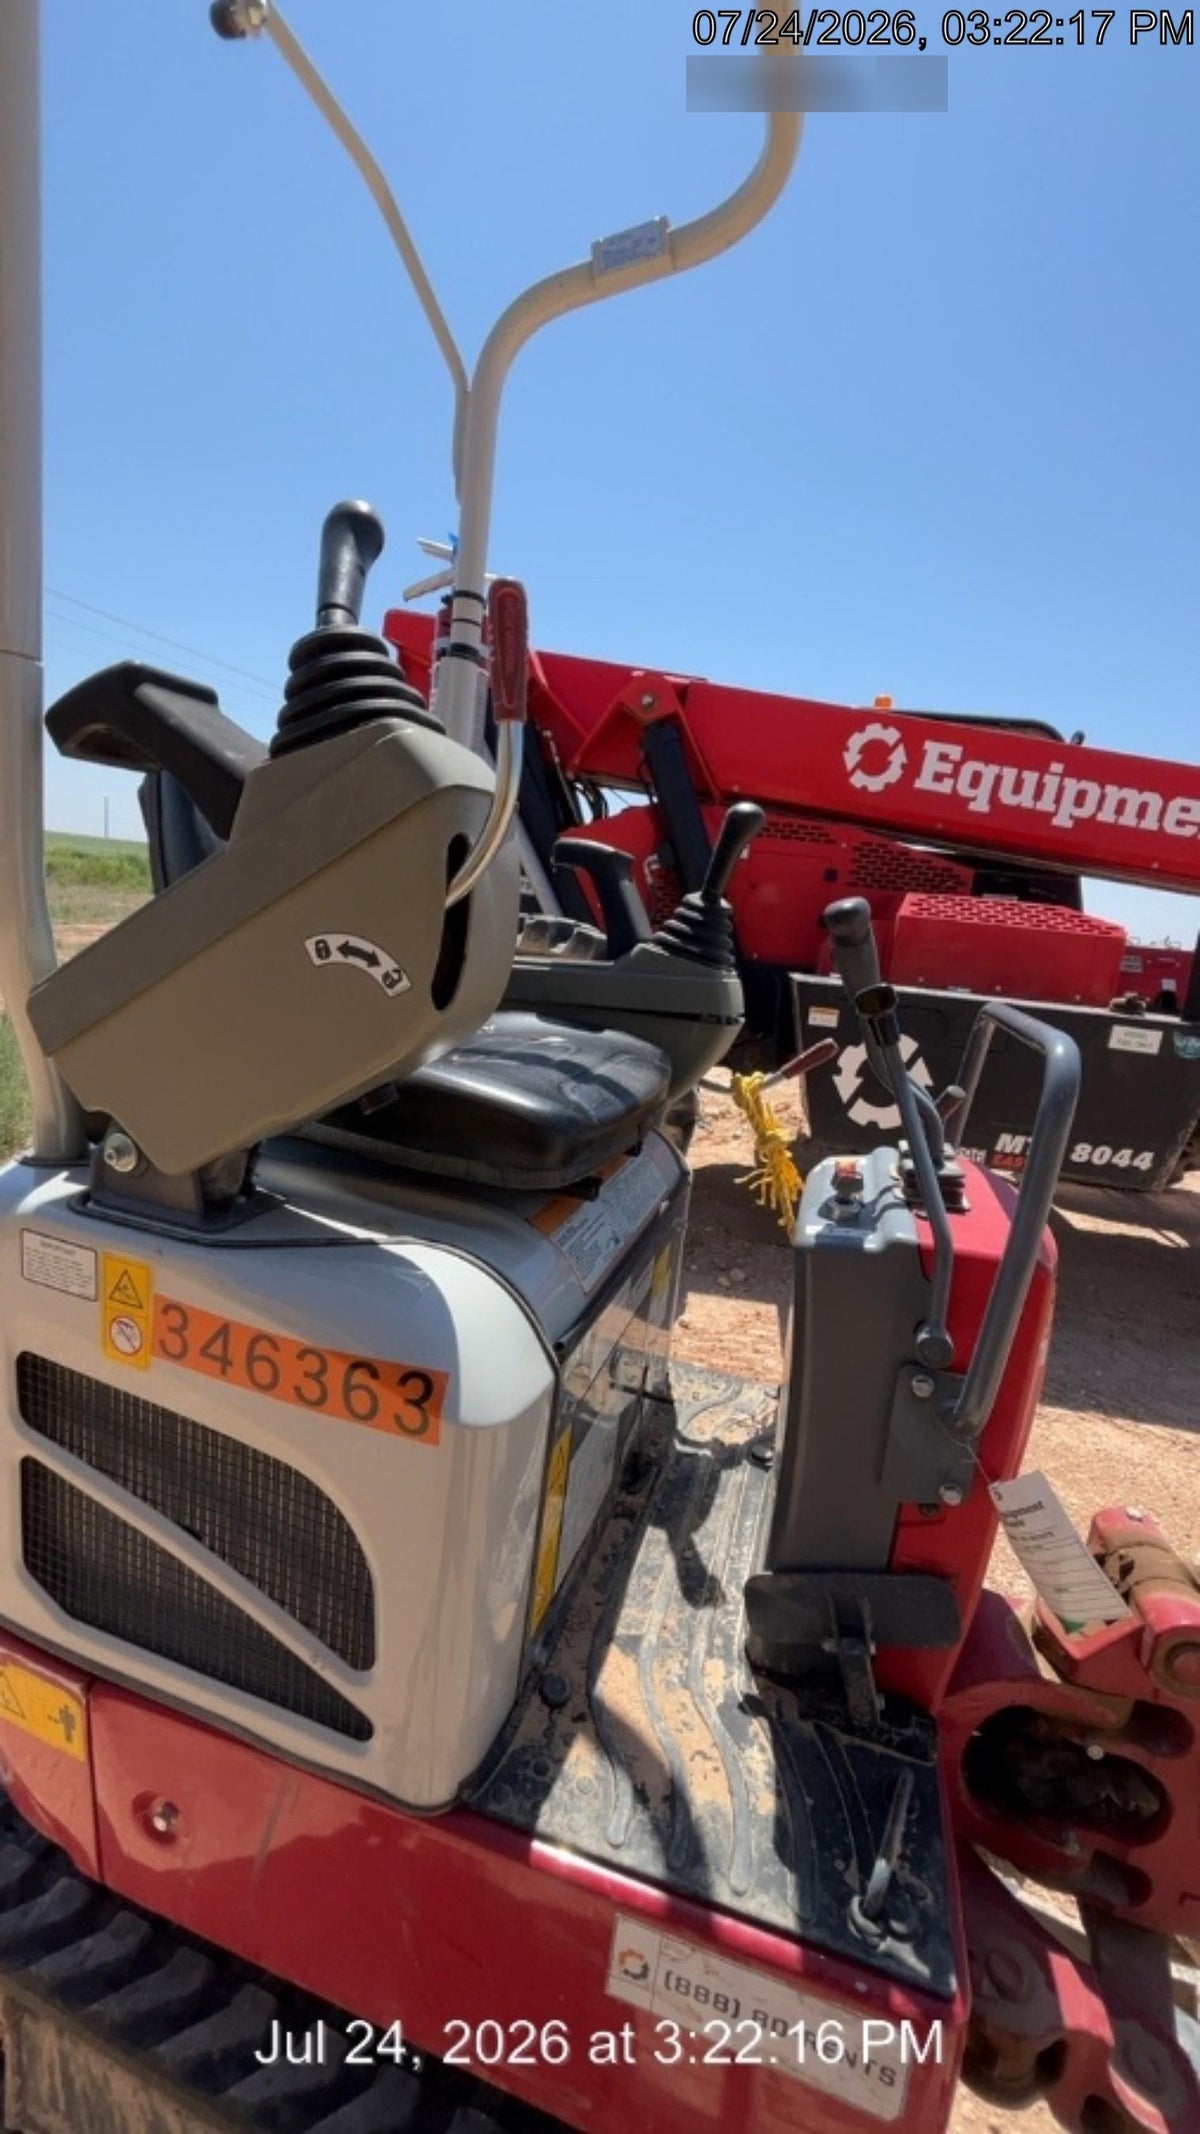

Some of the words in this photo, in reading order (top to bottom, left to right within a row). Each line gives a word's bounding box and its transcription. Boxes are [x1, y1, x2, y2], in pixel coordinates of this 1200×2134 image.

[914, 740, 1200, 838] Equipme
[1070, 1142, 1154, 1171] 8044
[158, 1303, 434, 1437] 346363
[664, 1970, 741, 2018] (888)
